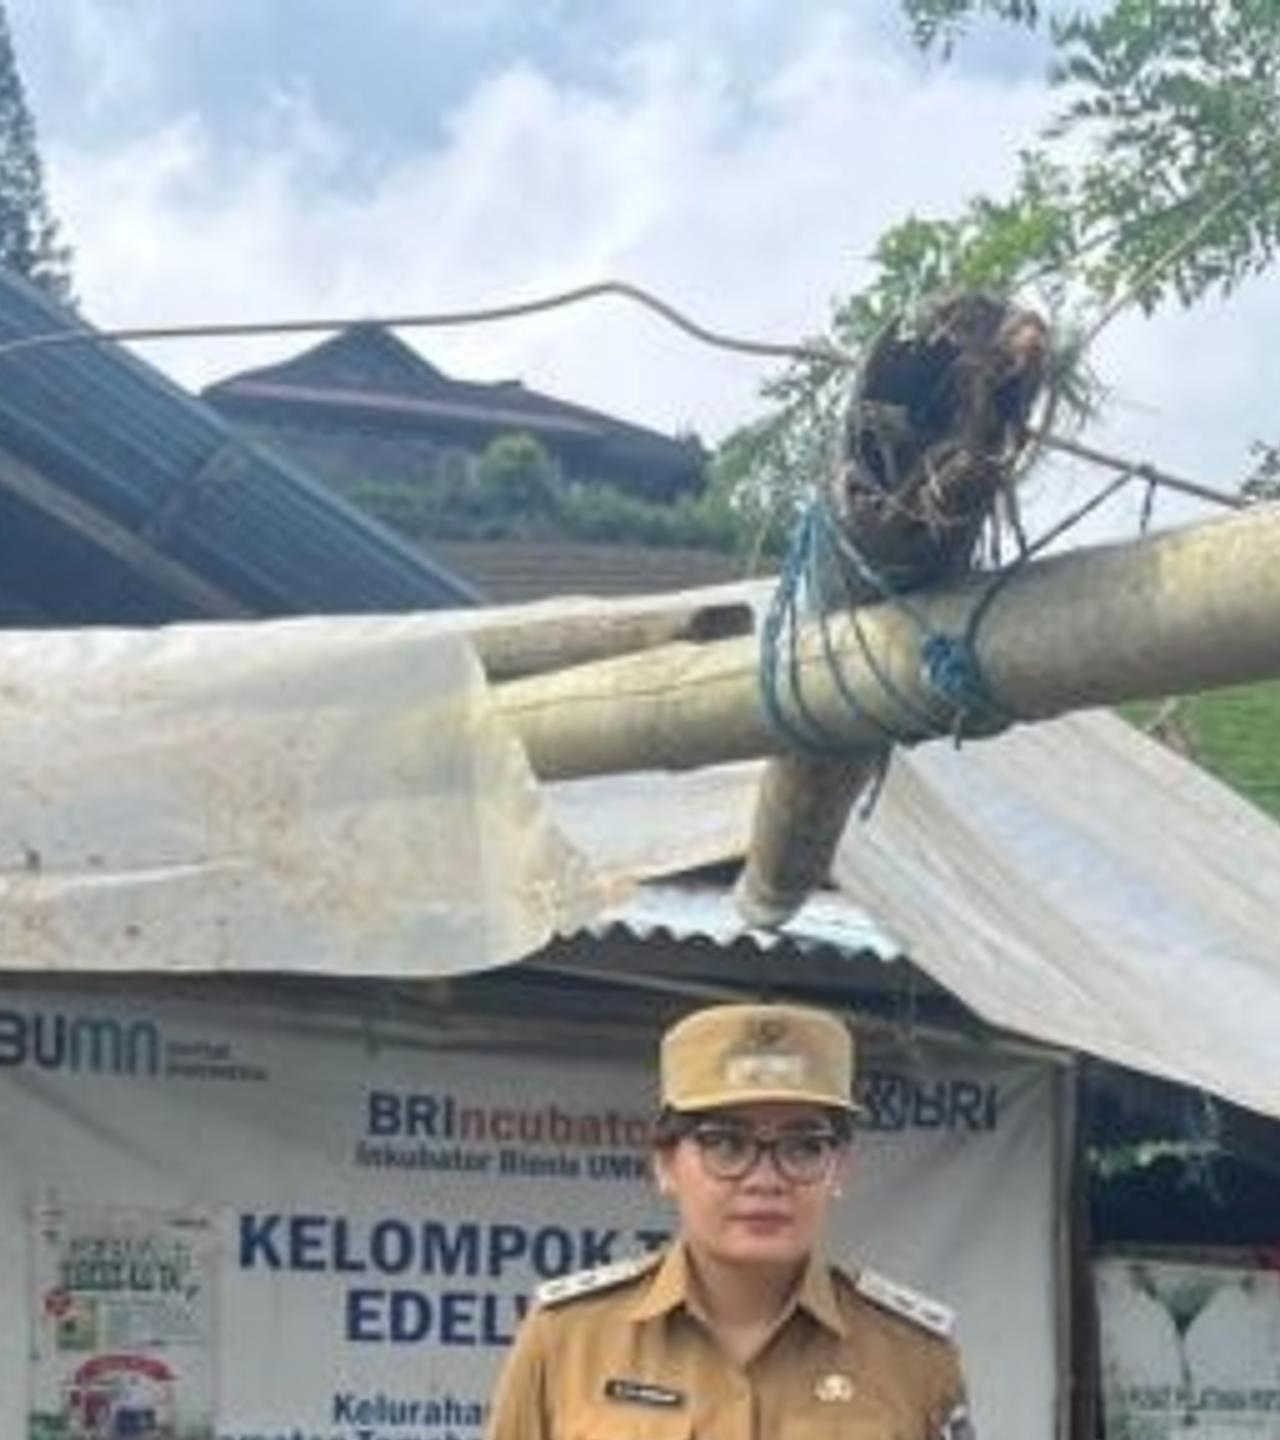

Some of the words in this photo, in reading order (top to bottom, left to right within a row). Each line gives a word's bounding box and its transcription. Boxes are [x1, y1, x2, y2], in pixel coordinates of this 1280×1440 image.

[239, 1213, 618, 1279] KELOMPOK
[345, 1288, 525, 1346] EDEL
[333, 1393, 491, 1426] Keluraha
